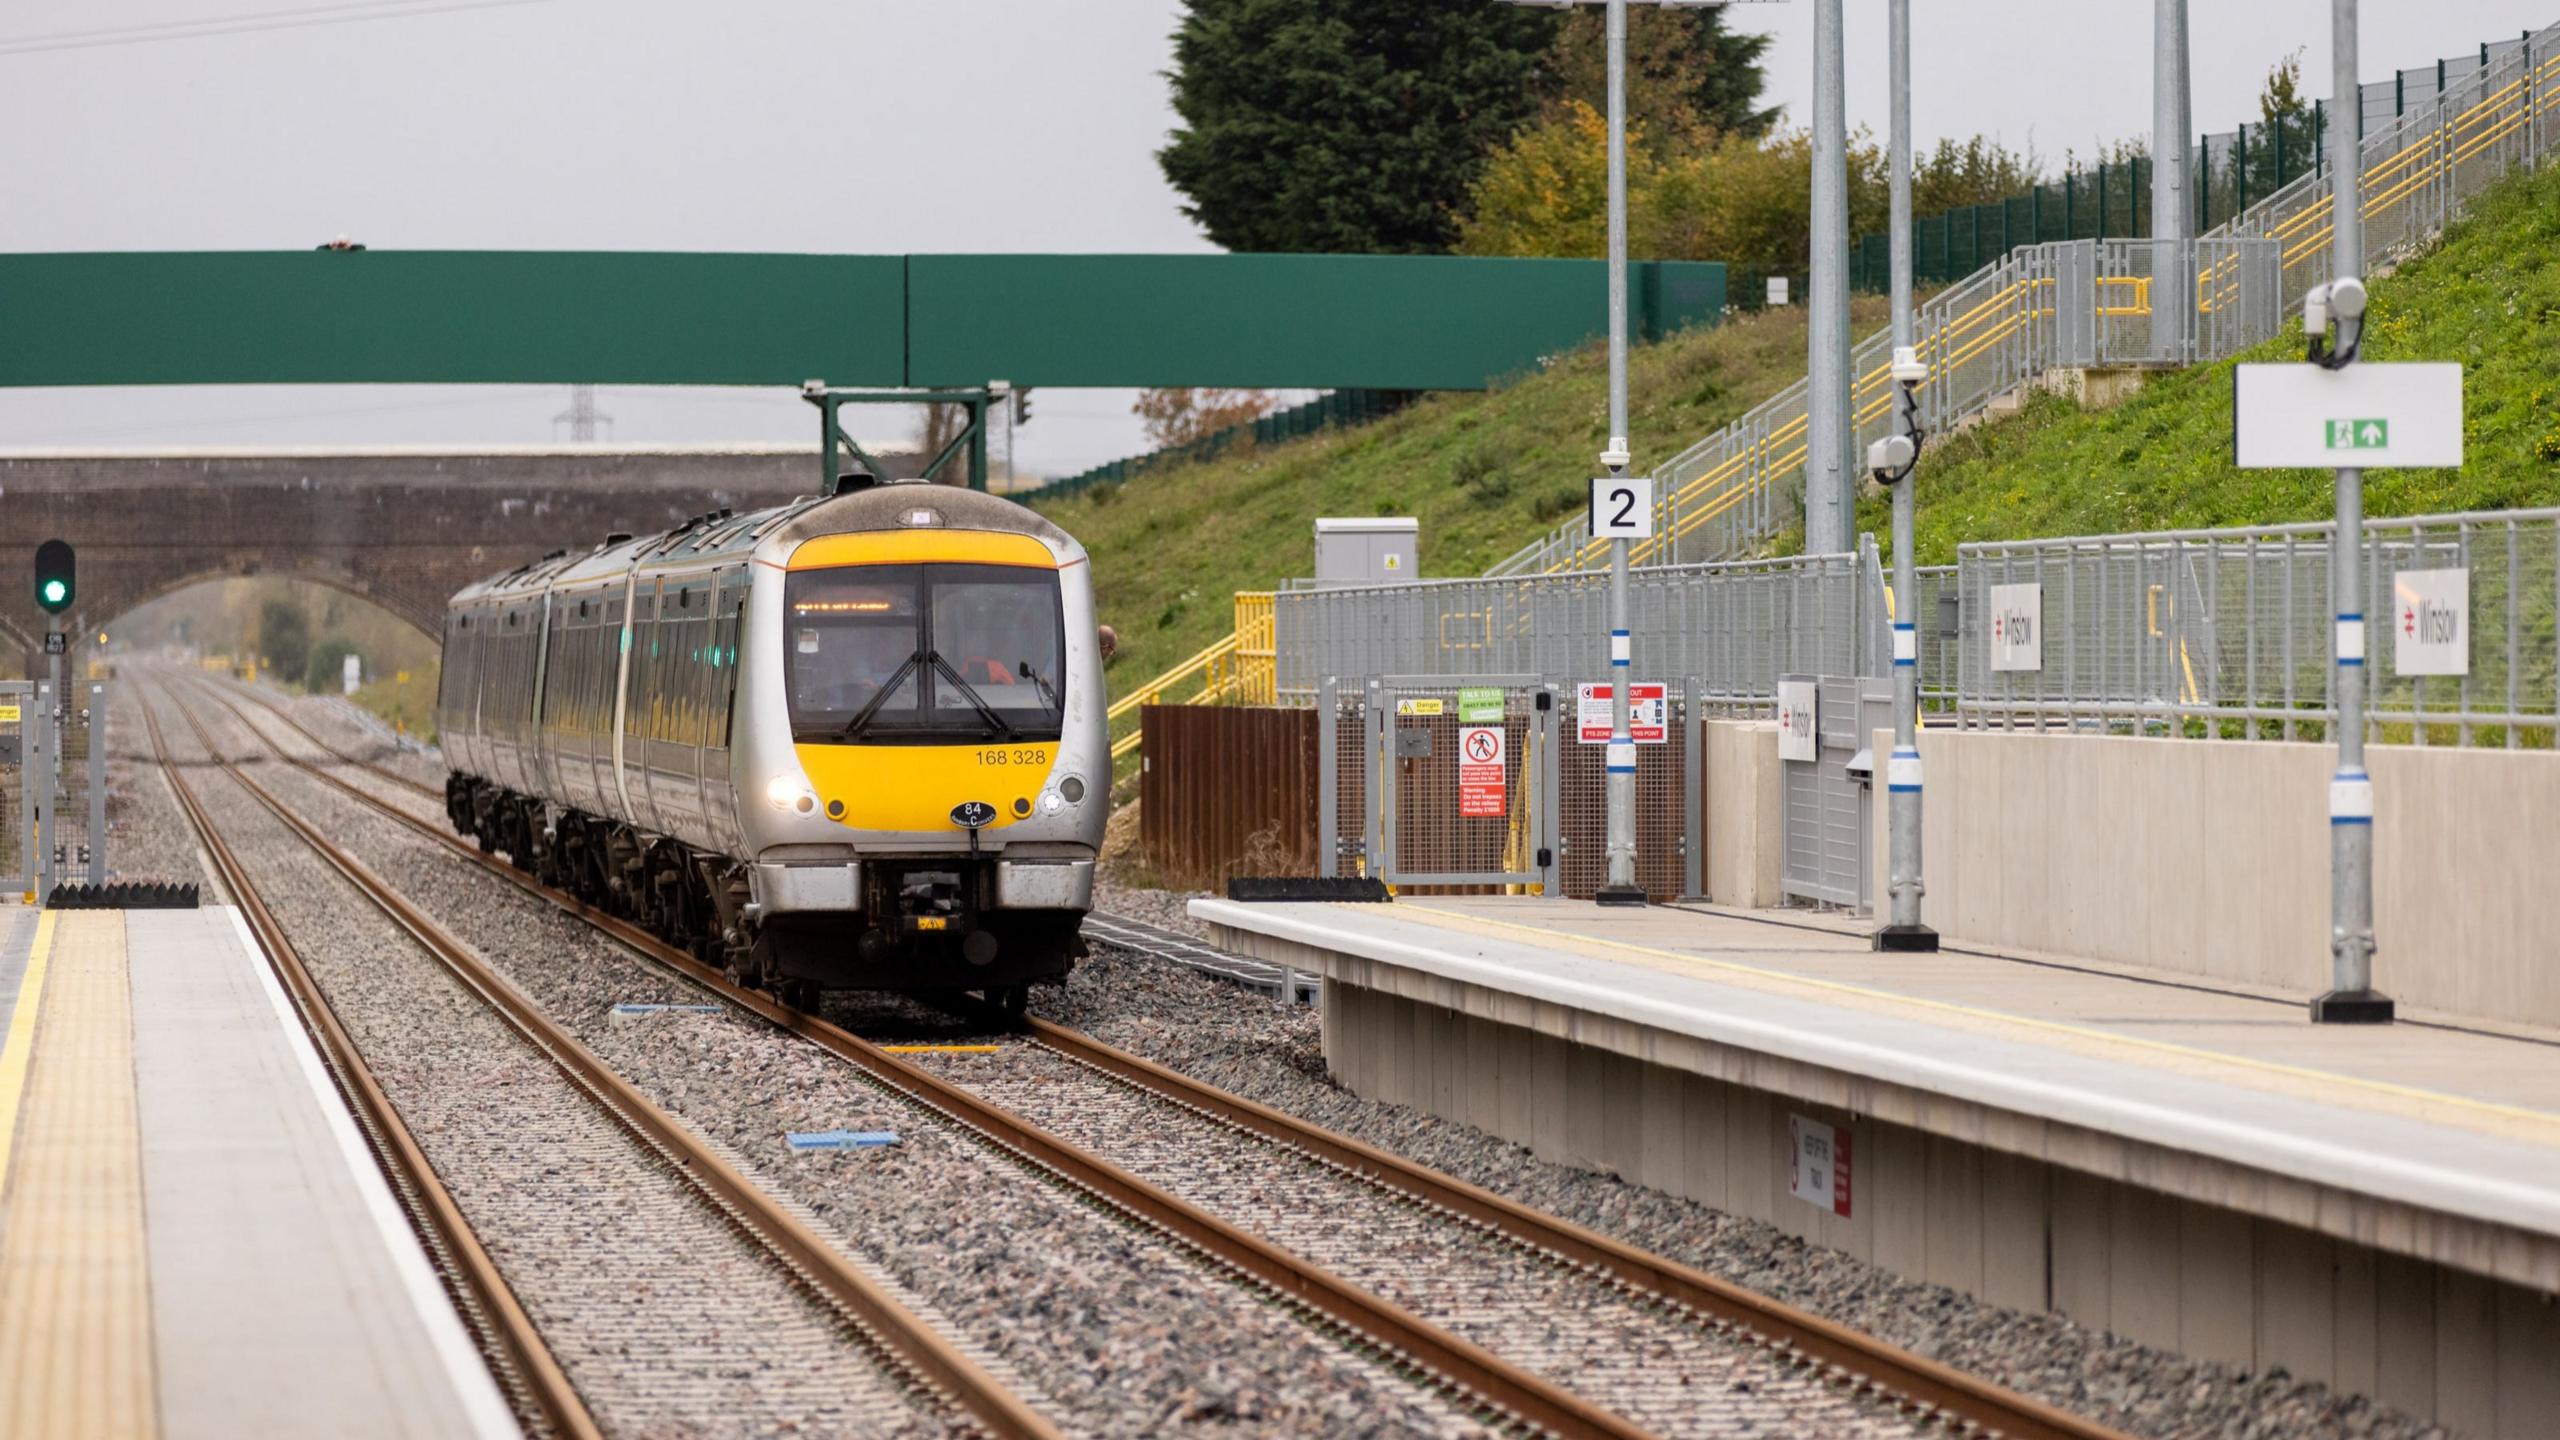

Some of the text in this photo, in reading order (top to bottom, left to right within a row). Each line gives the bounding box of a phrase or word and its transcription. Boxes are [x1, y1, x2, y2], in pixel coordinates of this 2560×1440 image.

[1610, 488, 1636, 527] 2
[2419, 597, 2458, 645] Winslow
[1630, 689, 1642, 697] OUT
[1416, 701, 1439, 709] Danger
[976, 749, 1046, 766] 168 328
[965, 803, 982, 815] 84
[970, 816, 977, 826] C
